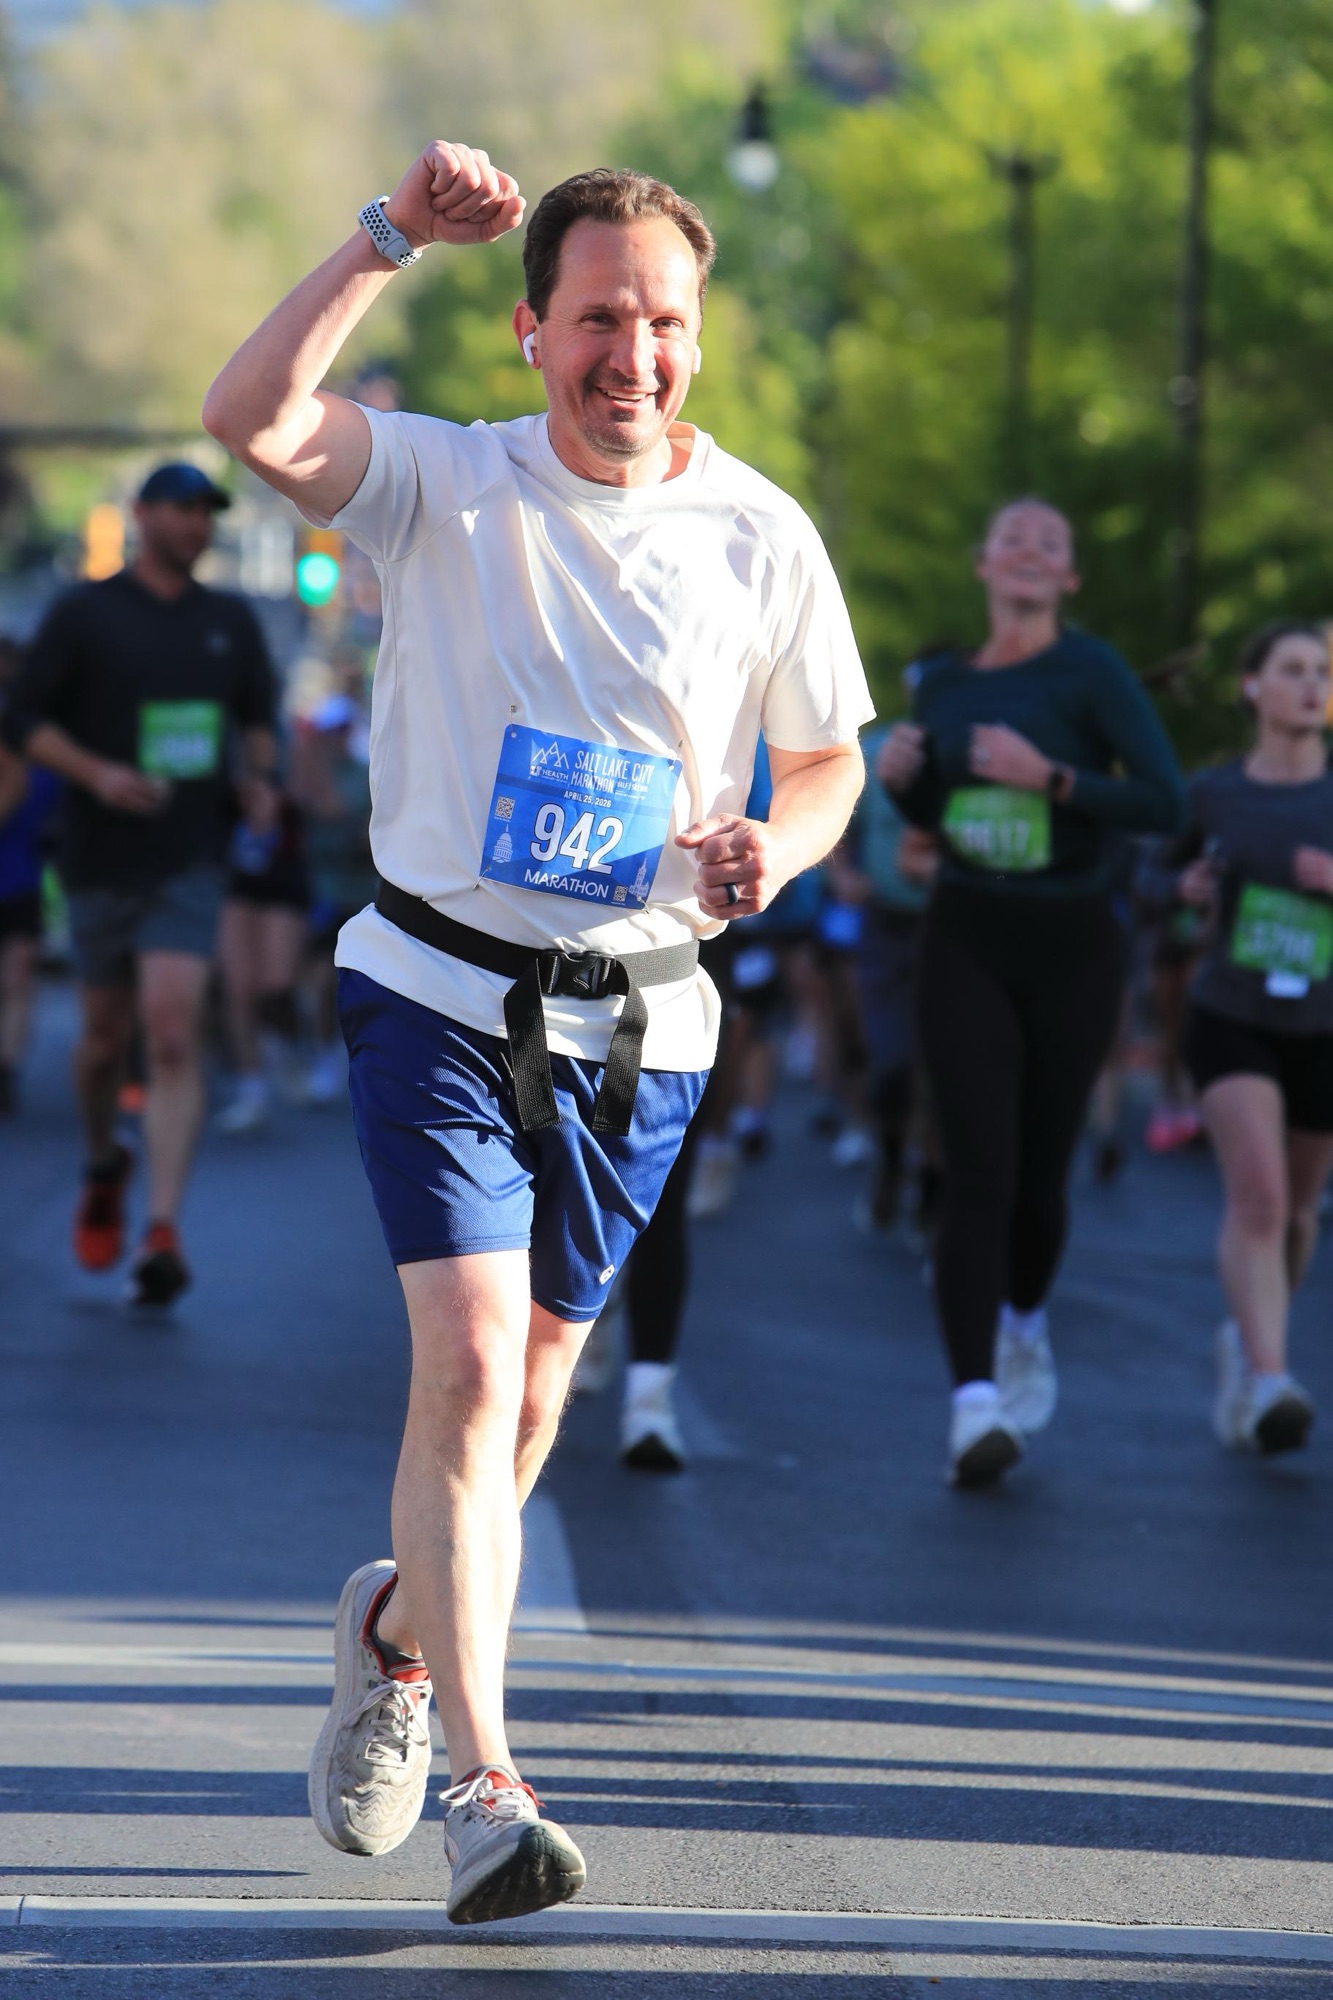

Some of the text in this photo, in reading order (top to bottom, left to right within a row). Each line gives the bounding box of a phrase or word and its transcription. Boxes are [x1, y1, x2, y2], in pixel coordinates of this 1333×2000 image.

[542, 769, 568, 780] HEALTH
[575, 750, 656, 785] SALT LAKE CITY
[570, 771, 615, 794] MARATHON
[564, 790, 612, 808] APRIL 25, 2026
[529, 803, 624, 875] 942
[525, 868, 609, 898] MARATHON
